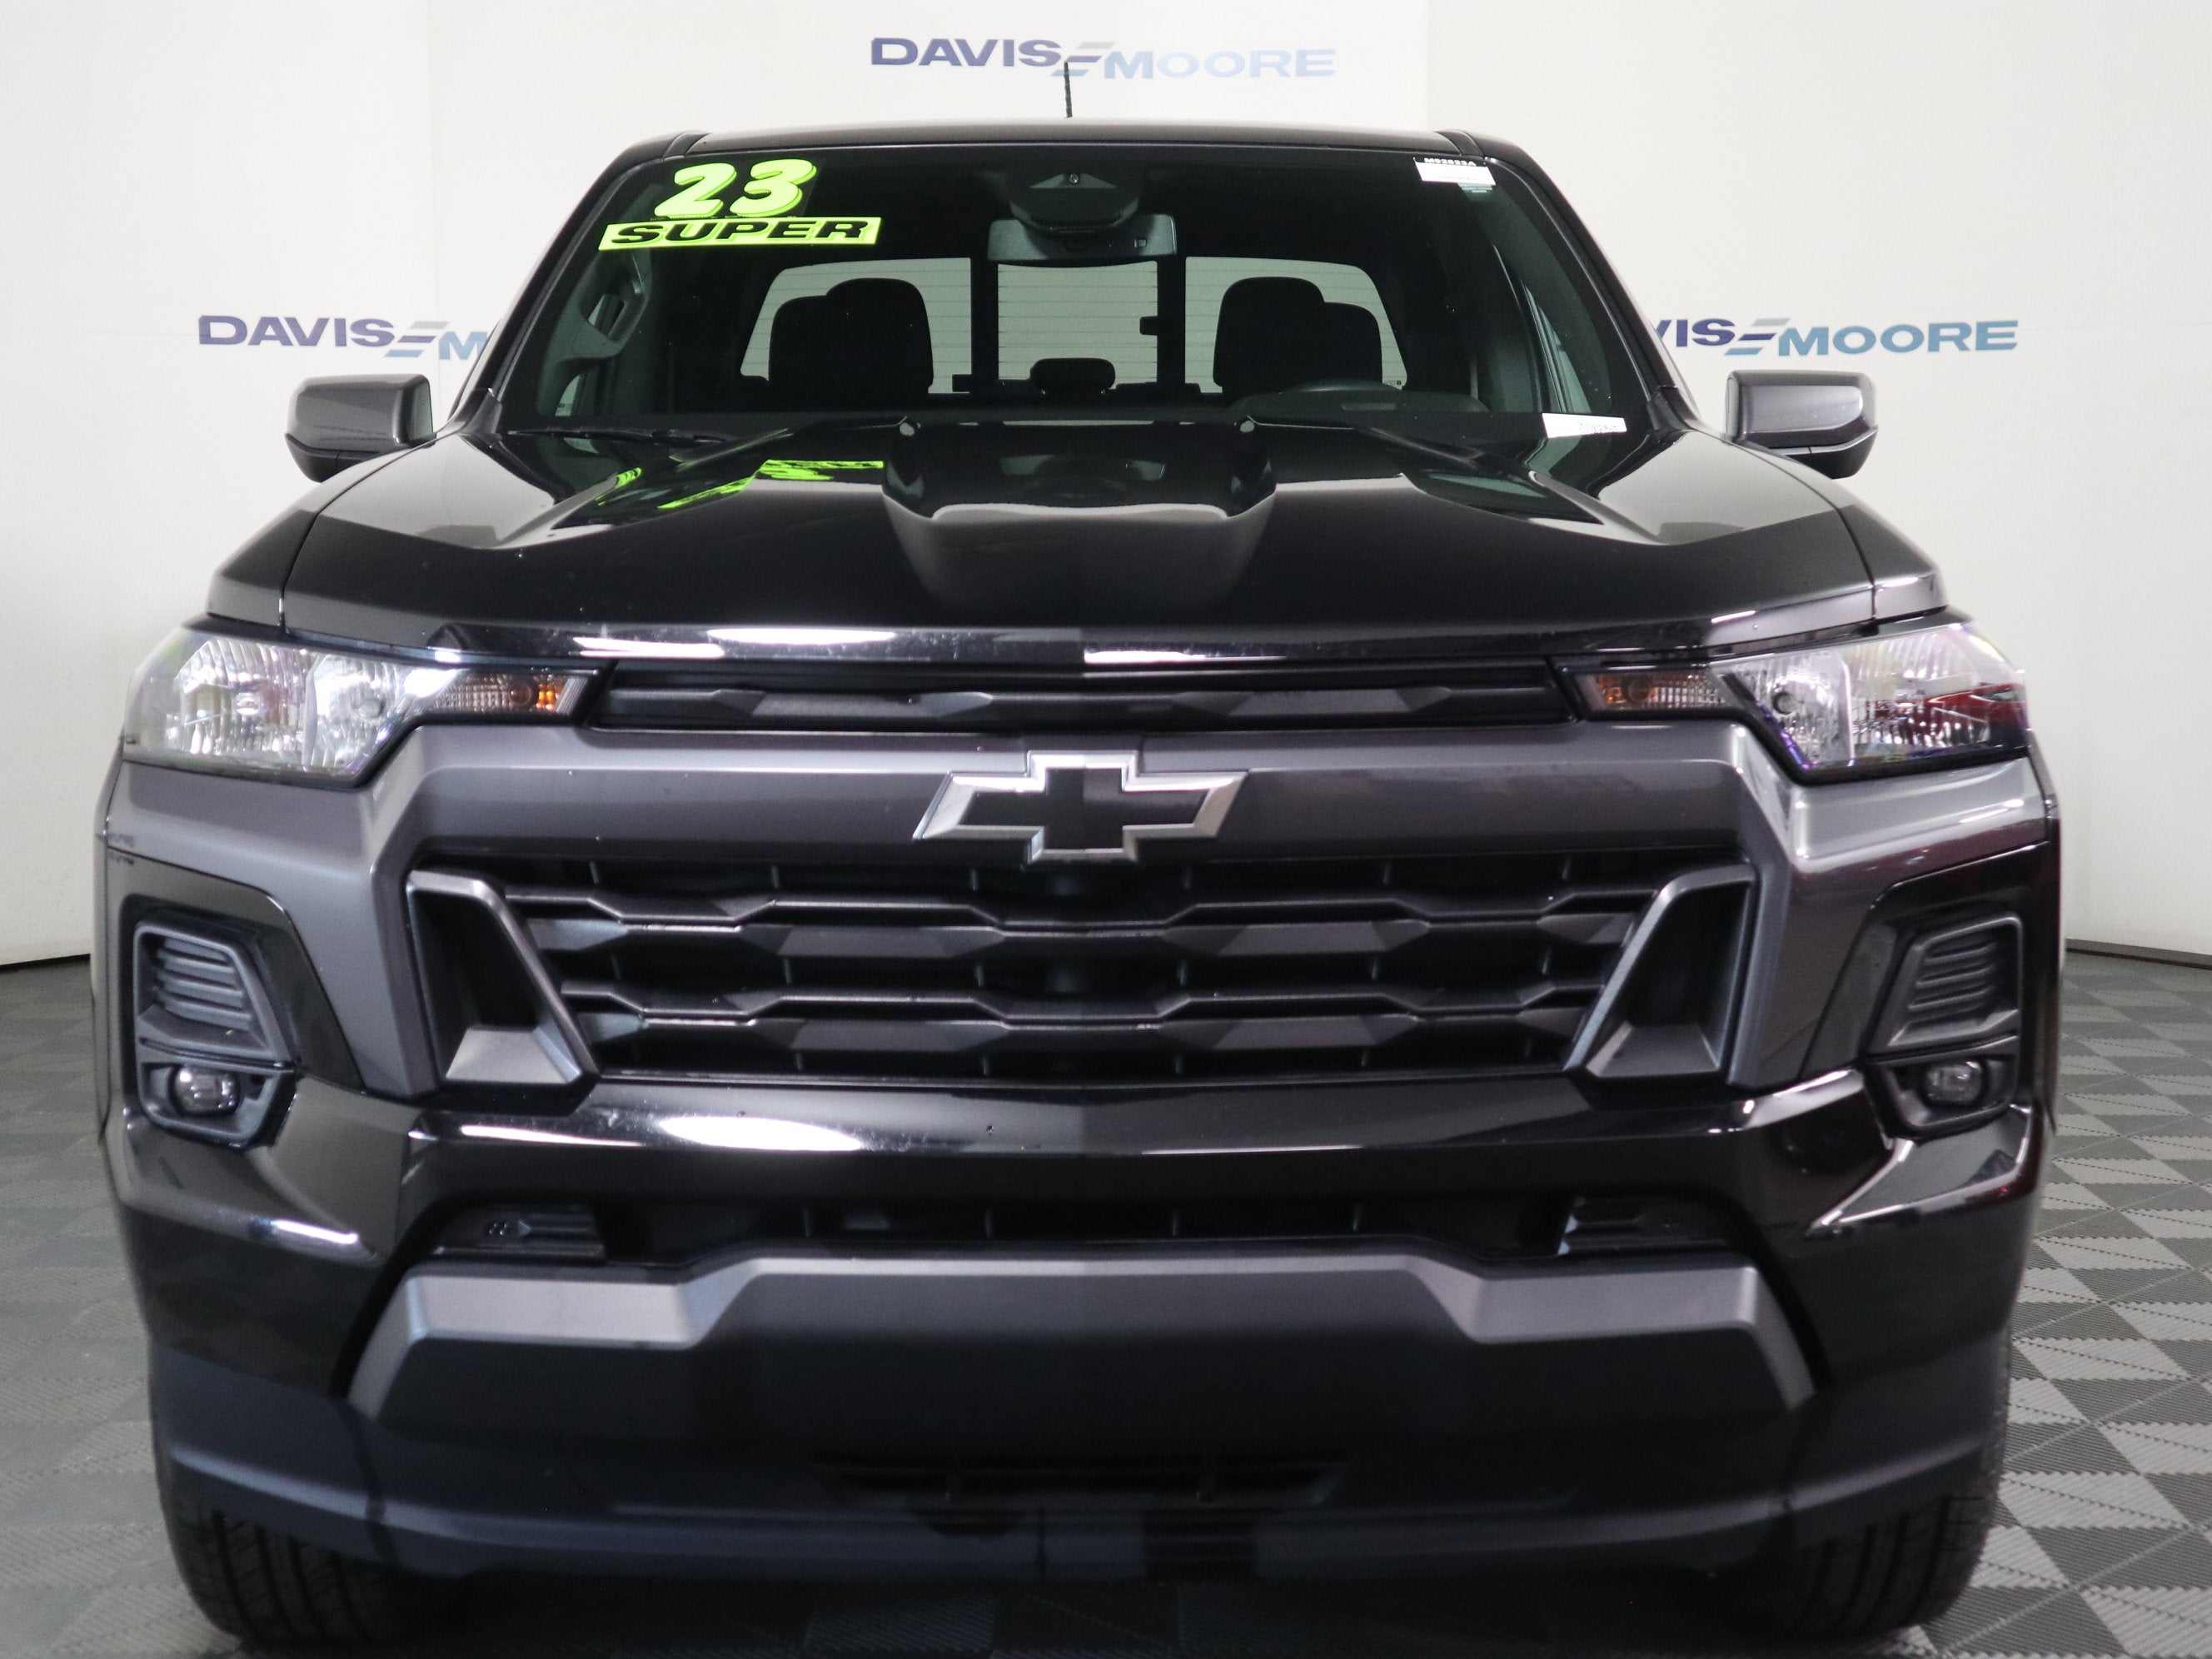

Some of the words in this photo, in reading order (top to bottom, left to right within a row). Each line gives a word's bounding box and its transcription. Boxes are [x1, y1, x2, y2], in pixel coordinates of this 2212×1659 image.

[870, 37, 1062, 67] DAVIS
[1104, 48, 1337, 80] MOORE
[654, 158, 818, 218] 23
[610, 219, 873, 245] SUPER
[197, 315, 396, 348] DAVIS
[1777, 319, 2020, 356] MOORE
